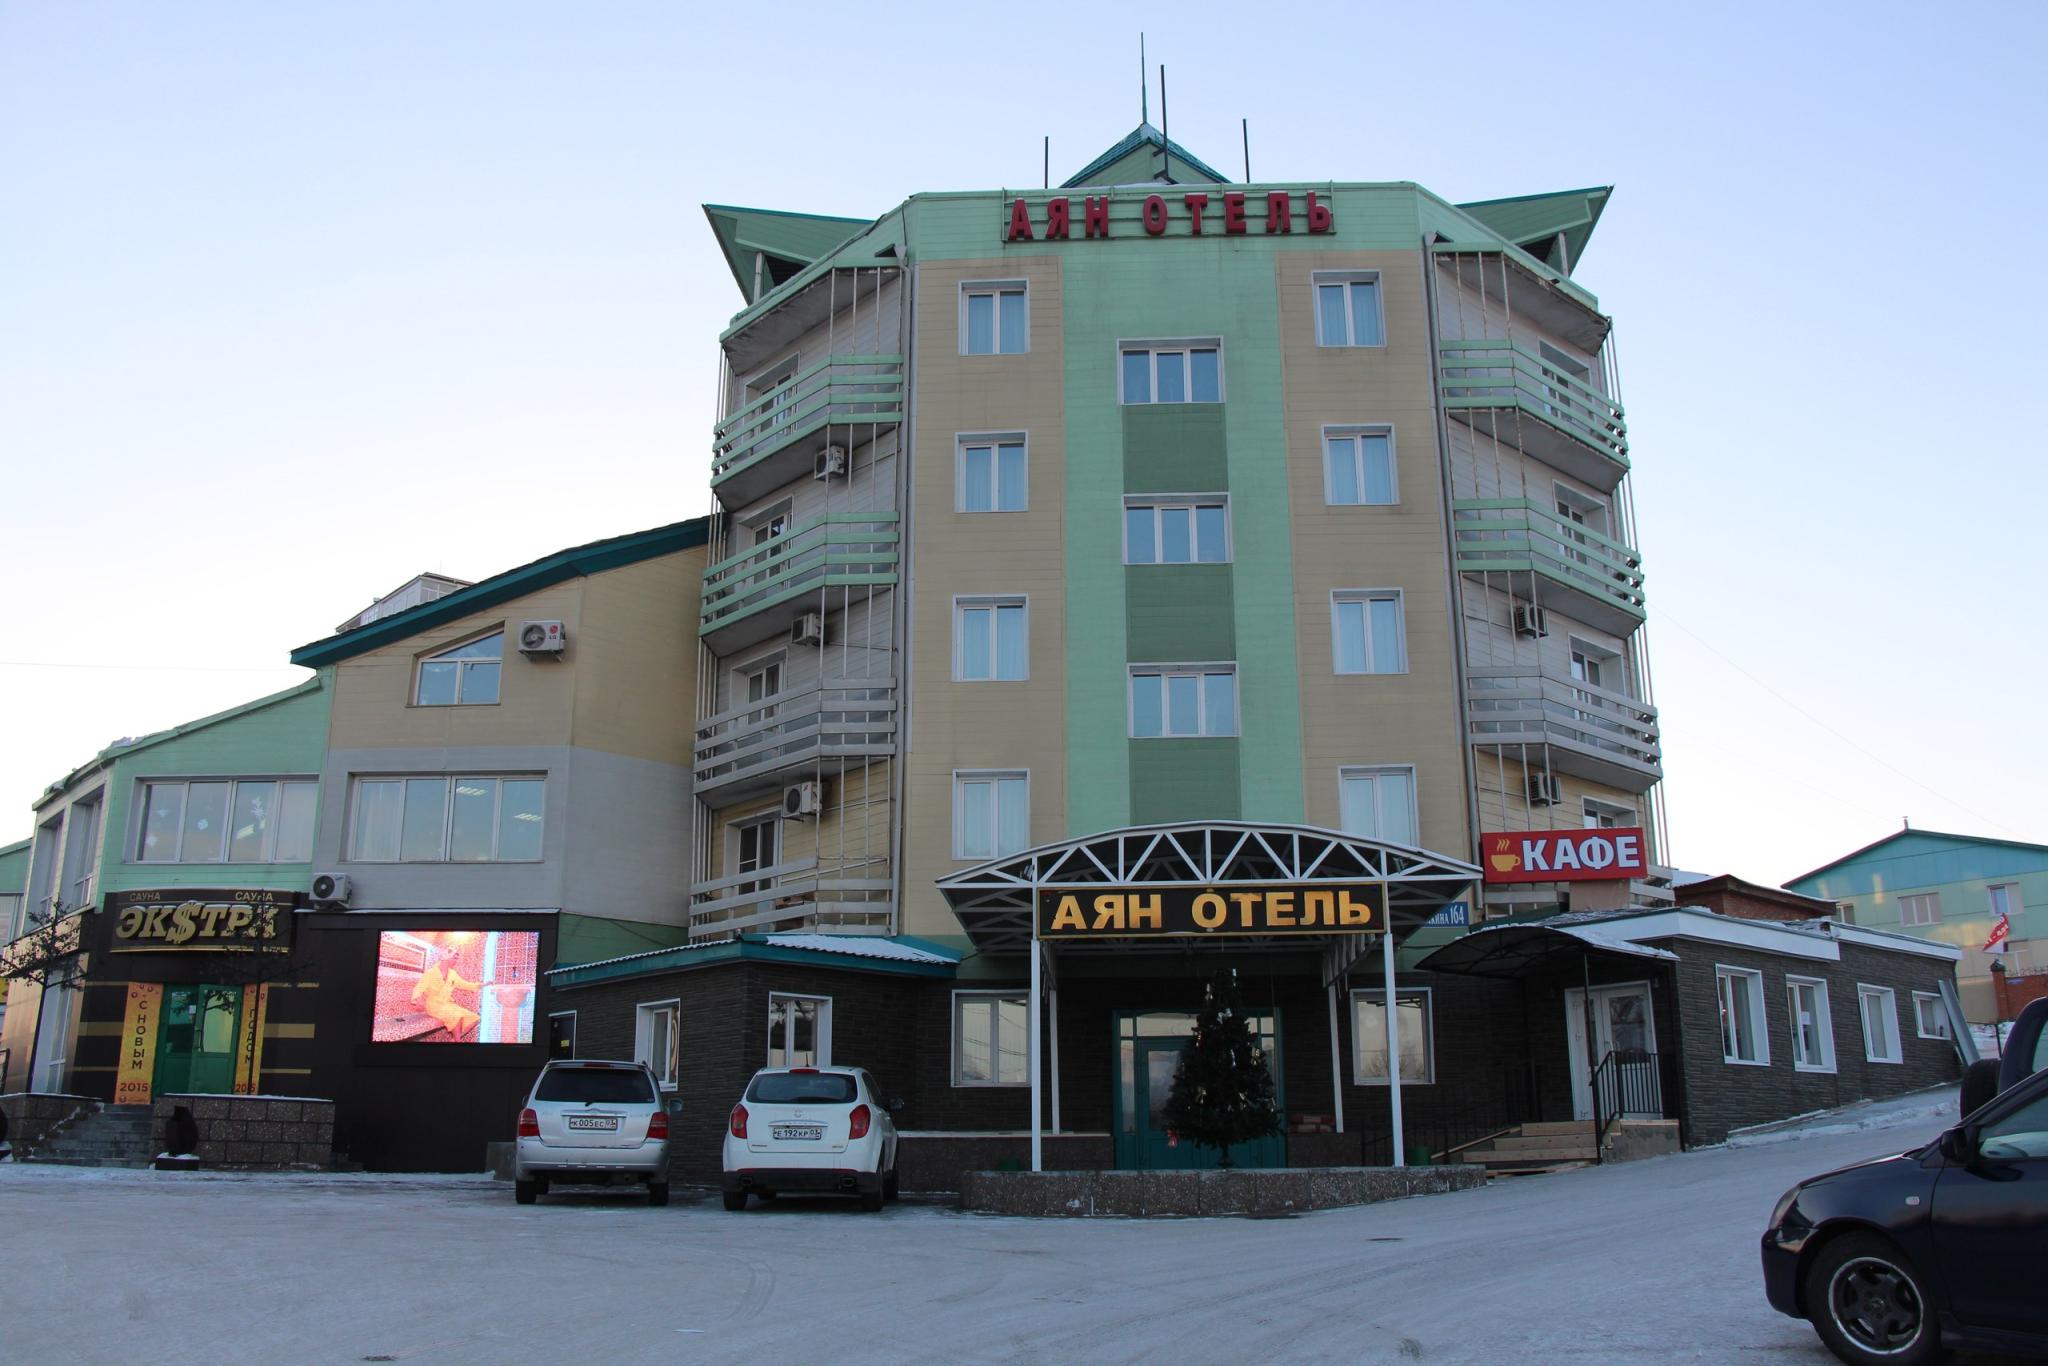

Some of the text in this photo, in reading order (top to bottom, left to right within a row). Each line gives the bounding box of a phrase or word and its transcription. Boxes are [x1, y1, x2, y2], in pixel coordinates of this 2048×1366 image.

[1007, 190, 1334, 240] АЯН ОТЕЛЬ
[1522, 835, 1640, 871] КАФЕ
[129, 891, 161, 901] САУНА
[1050, 890, 1372, 930] АЯН ОТЕЛЬ
[1428, 904, 1465, 924] КИНА 164
[131, 1000, 148, 1070] С НОВЫМ
[120, 1082, 149, 1092] 2015
[235, 1084, 256, 1093] 205
